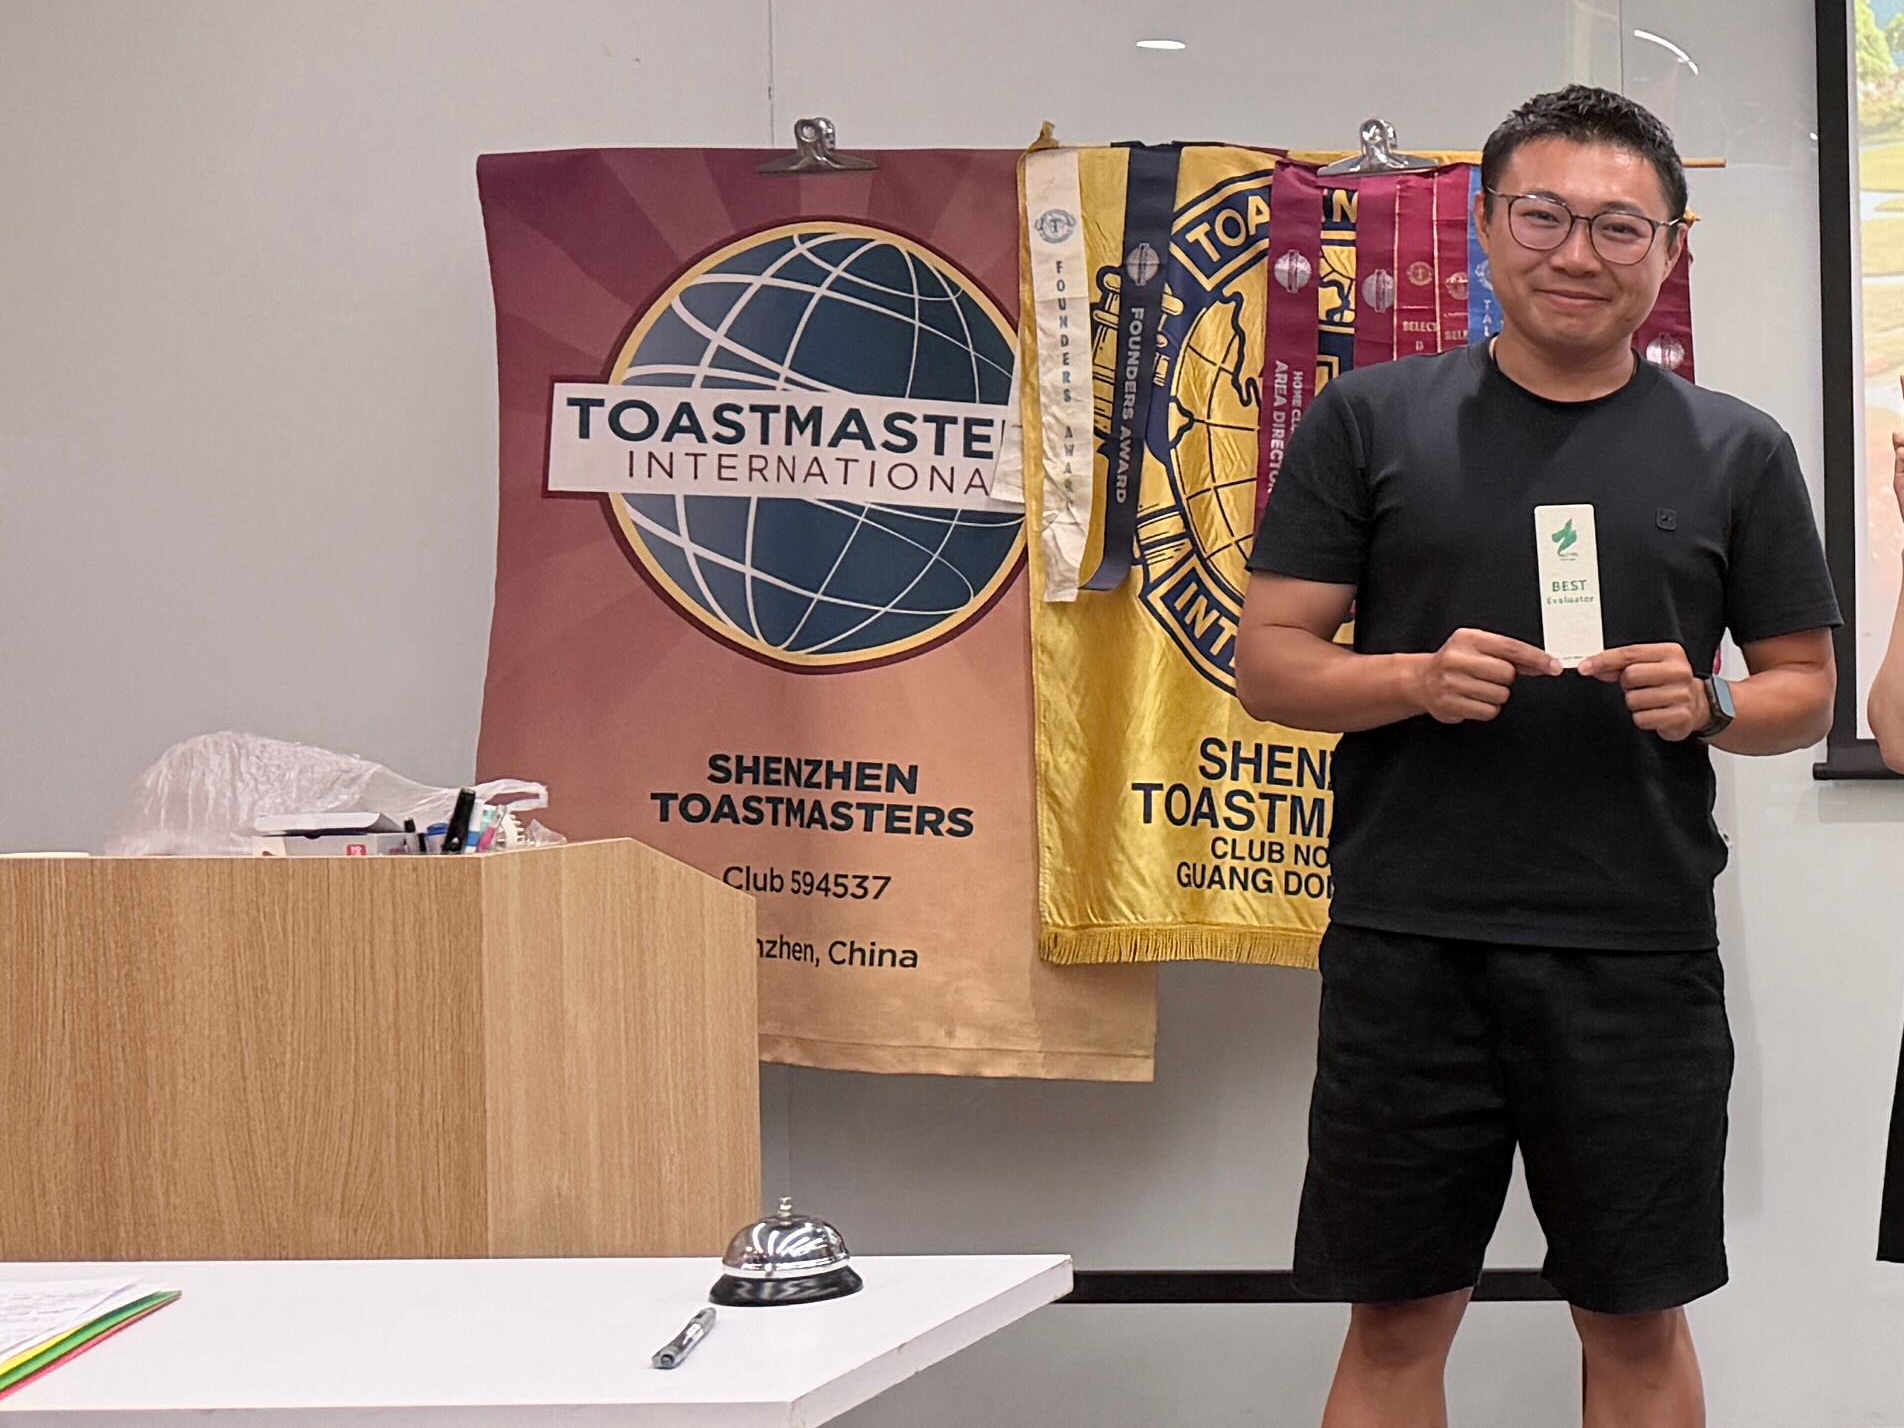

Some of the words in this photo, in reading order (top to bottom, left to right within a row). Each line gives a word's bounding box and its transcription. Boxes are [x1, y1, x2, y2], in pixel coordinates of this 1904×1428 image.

[1185, 195, 1271, 263] TOA
[1056, 261, 1072, 403] FOUNDERS
[1122, 308, 1145, 420] FOUNDERS
[1273, 360, 1288, 406] AREA
[567, 397, 1005, 460] TOASTMASTE
[628, 450, 989, 497] INTERNATIONA
[1116, 426, 1132, 503] AWARD
[1552, 580, 1587, 592] BEST
[1174, 581, 1238, 668] INT
[708, 754, 918, 795] SHENZHEN
[1199, 737, 1334, 790] SHEN
[651, 792, 975, 838] TOASTMASTERS
[1131, 783, 1332, 838] TOASTM
[1211, 836, 1284, 864] CLUB
[723, 867, 784, 894] Club
[791, 871, 892, 900] 594537
[1177, 861, 1274, 893] GUANG
[828, 941, 919, 969] China
